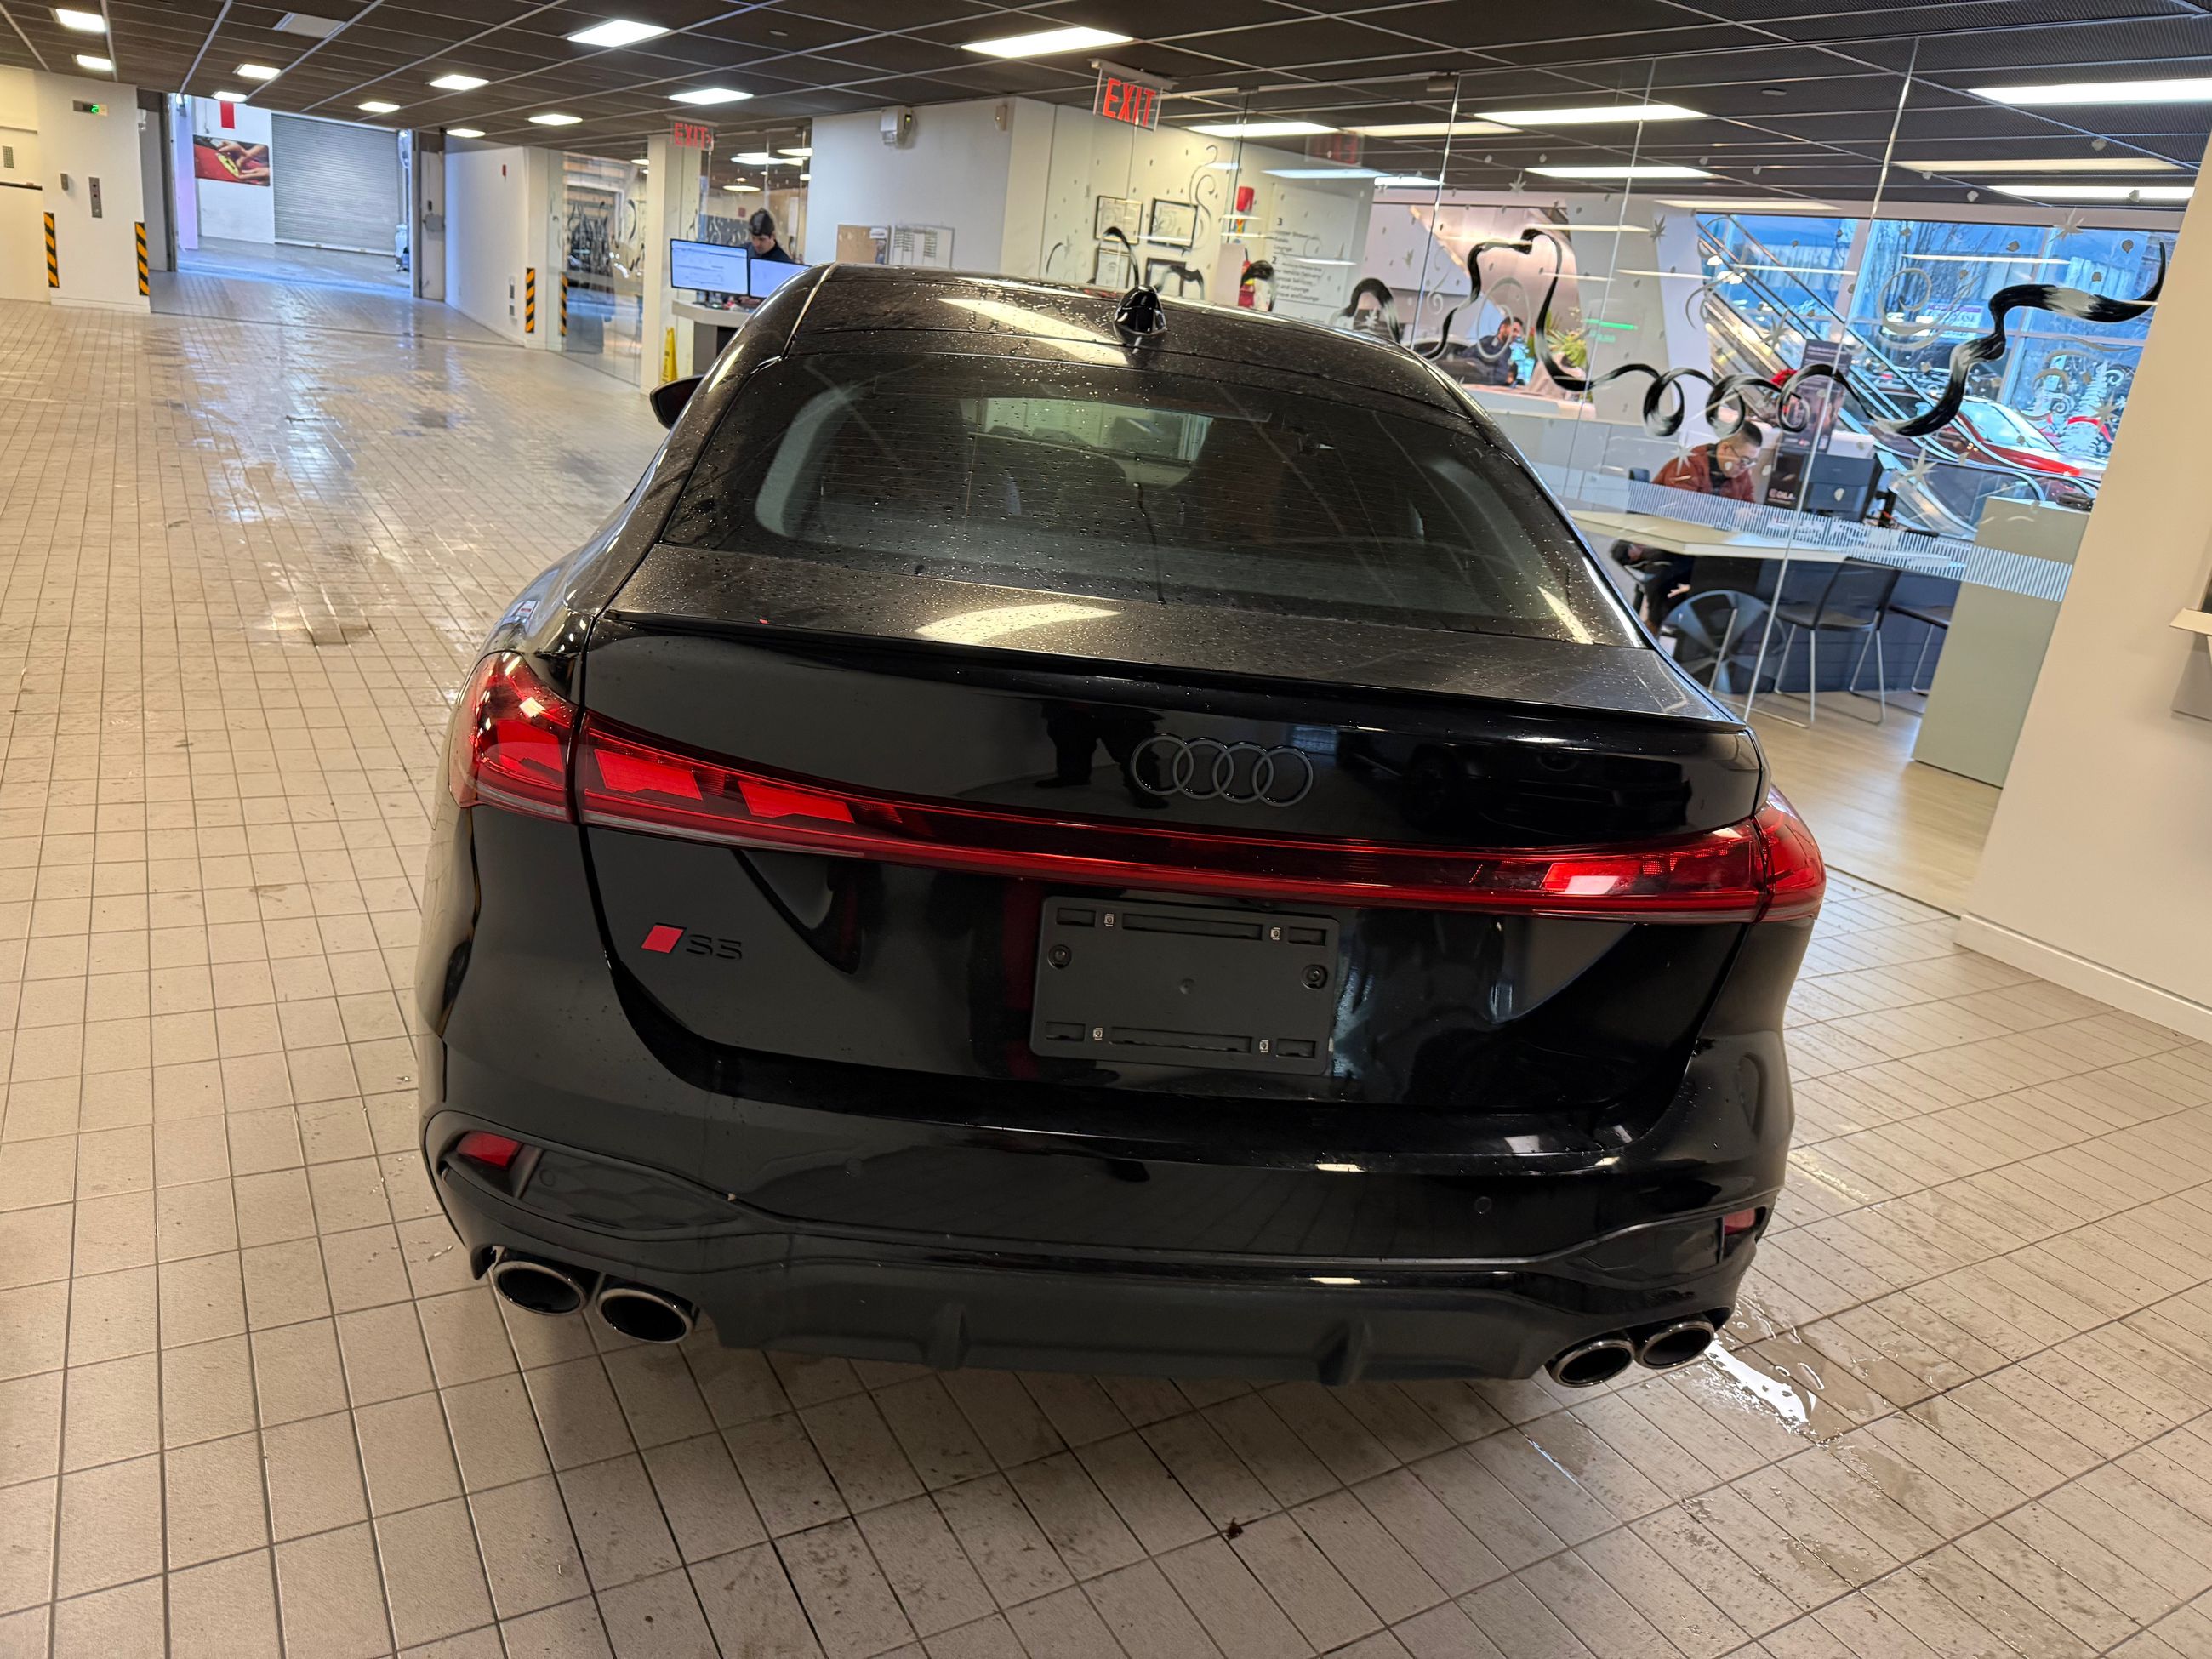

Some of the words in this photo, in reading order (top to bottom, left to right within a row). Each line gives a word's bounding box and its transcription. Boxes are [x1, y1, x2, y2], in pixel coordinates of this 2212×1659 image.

[1103, 77, 1156, 127] EXIT
[675, 123, 708, 150] EXIT
[1277, 217, 1283, 226] 3
[1272, 256, 1277, 265] 2
[686, 934, 742, 960] S5
